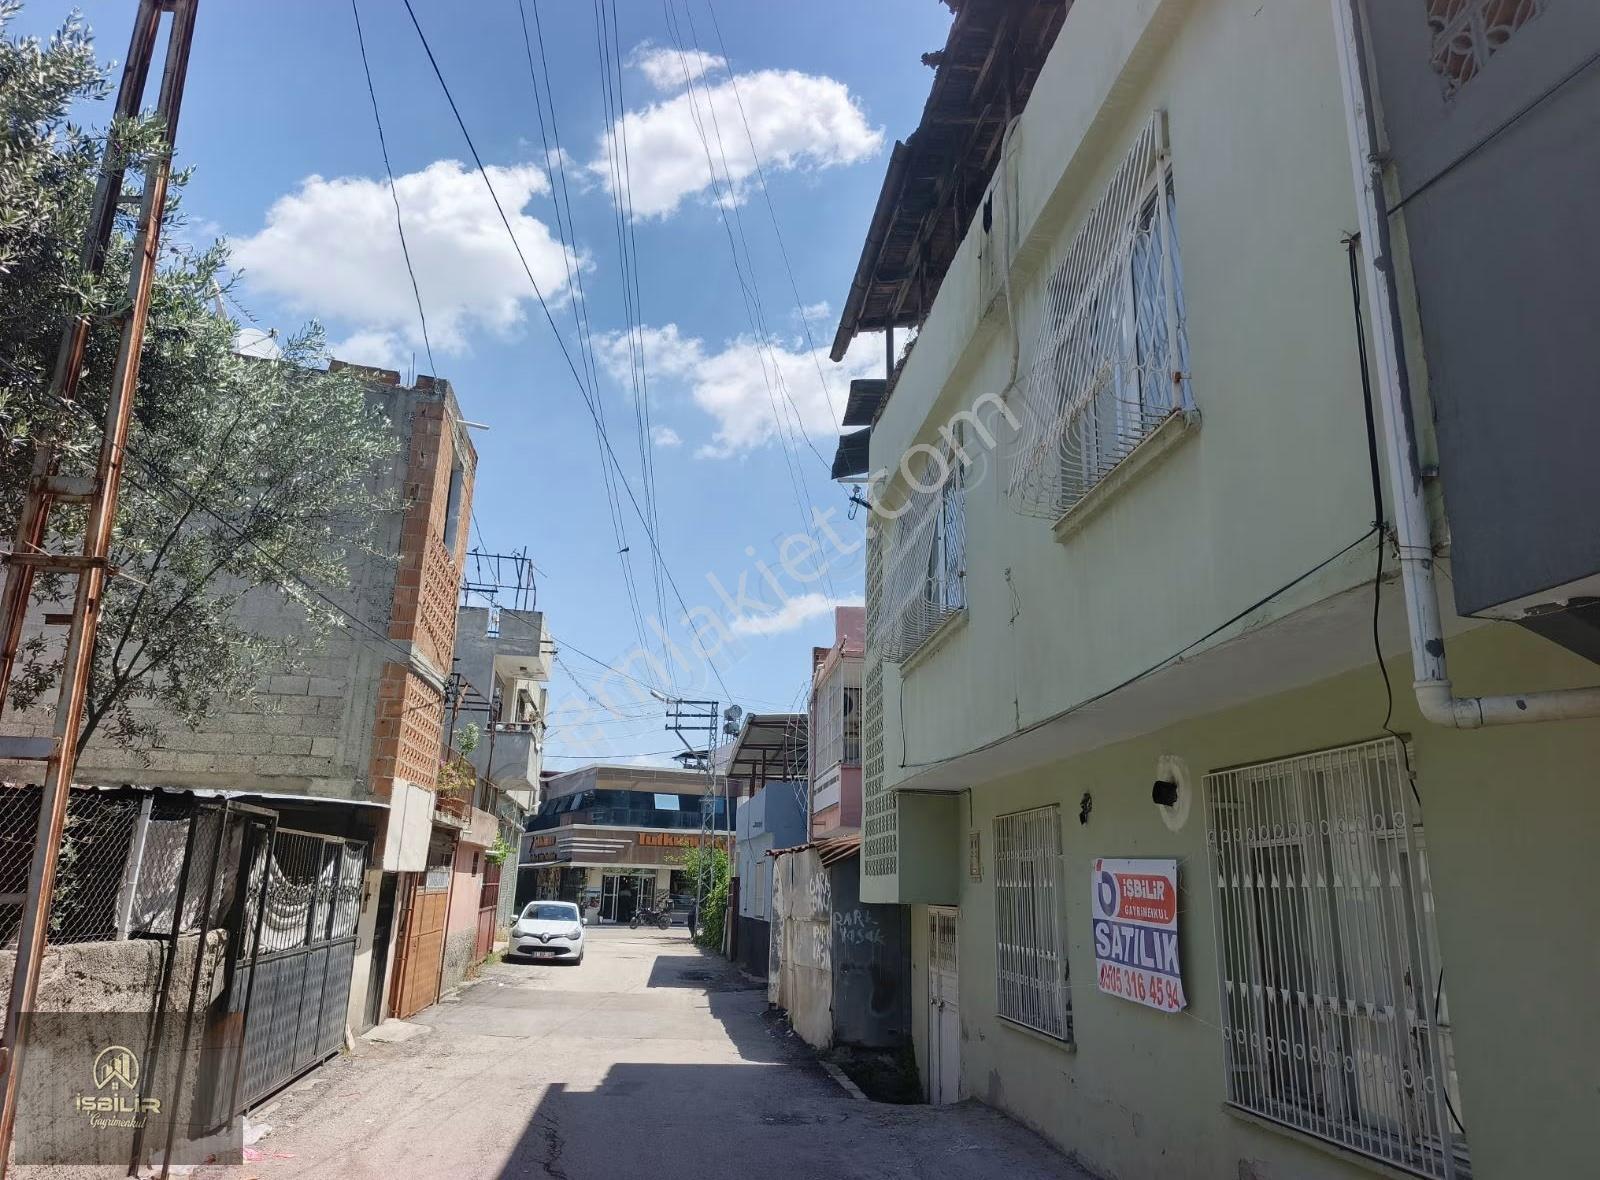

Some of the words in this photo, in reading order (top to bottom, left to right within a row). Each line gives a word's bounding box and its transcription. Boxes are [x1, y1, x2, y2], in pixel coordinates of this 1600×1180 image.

[1095, 922, 1180, 975] SATILIK
[1124, 971, 1146, 1003] 316
[1149, 974, 1164, 1006] 45
[1165, 979, 1181, 1009] 94
